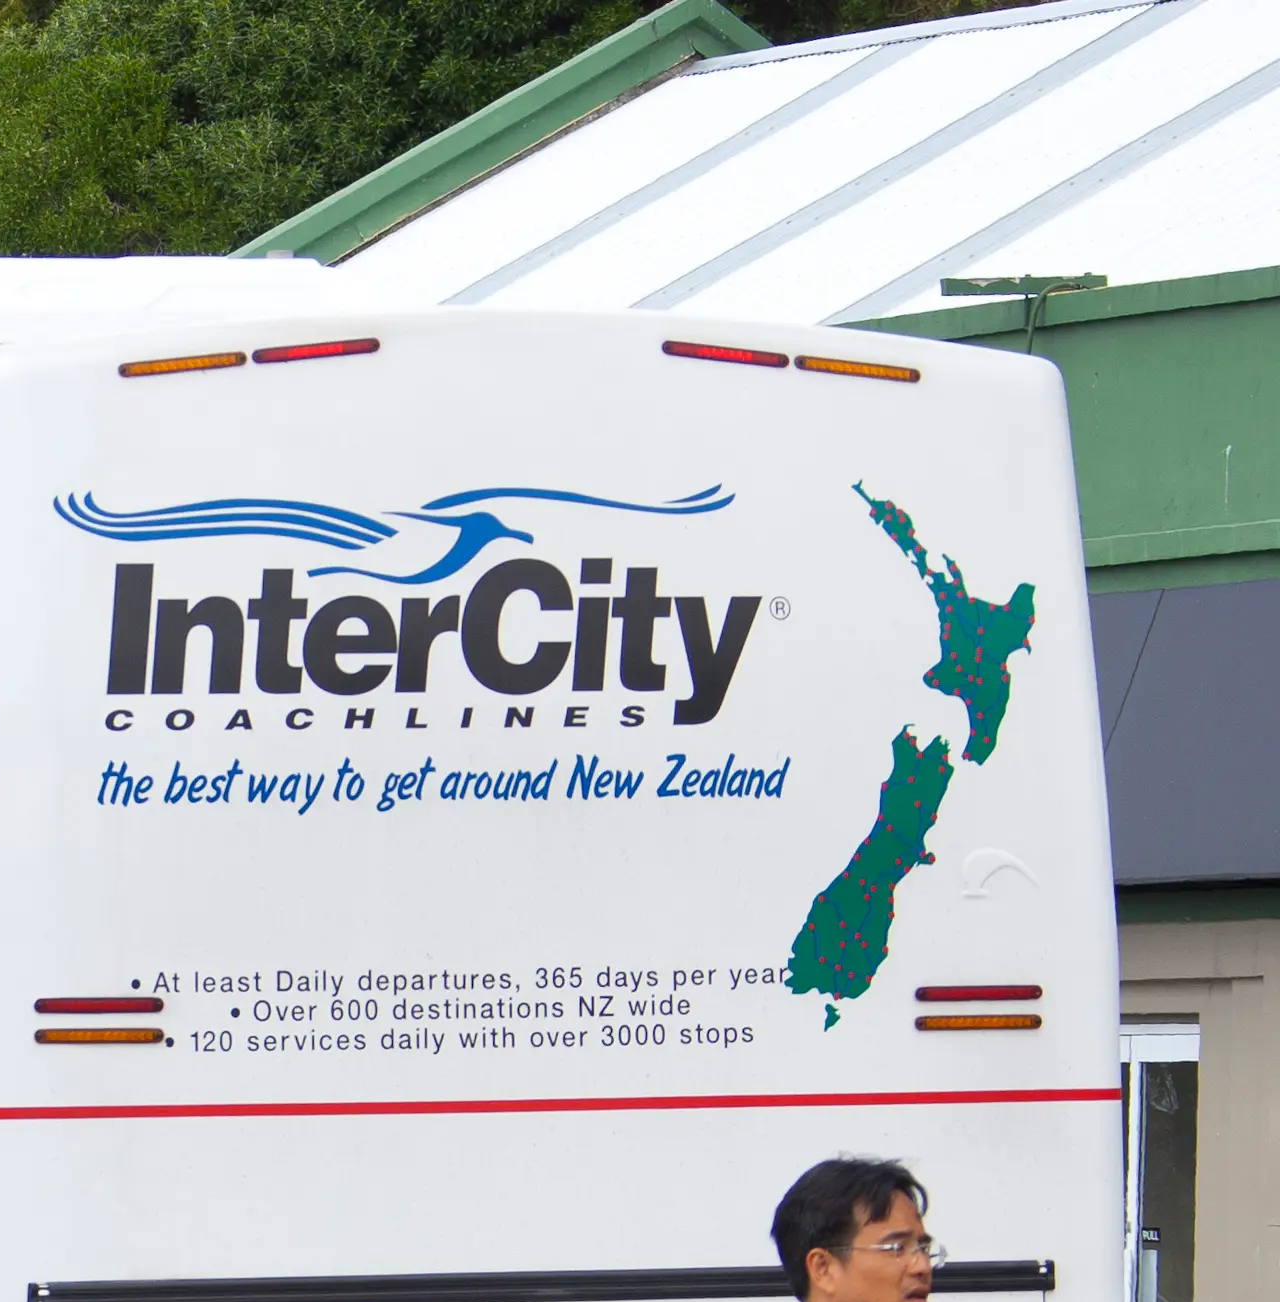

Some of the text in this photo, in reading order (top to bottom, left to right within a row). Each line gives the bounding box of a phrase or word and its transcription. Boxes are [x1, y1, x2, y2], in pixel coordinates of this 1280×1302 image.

[106, 558, 762, 726] InterCity
[105, 705, 645, 732] COACHLINES
[97, 753, 791, 816] the best way to get around New Zealand
[153, 966, 787, 997] At least Daily departures, 365 days per year
[253, 994, 691, 1022] Over 600 destinations NZ wide
[190, 1023, 754, 1055] 120 services daily with over 3000 stops
